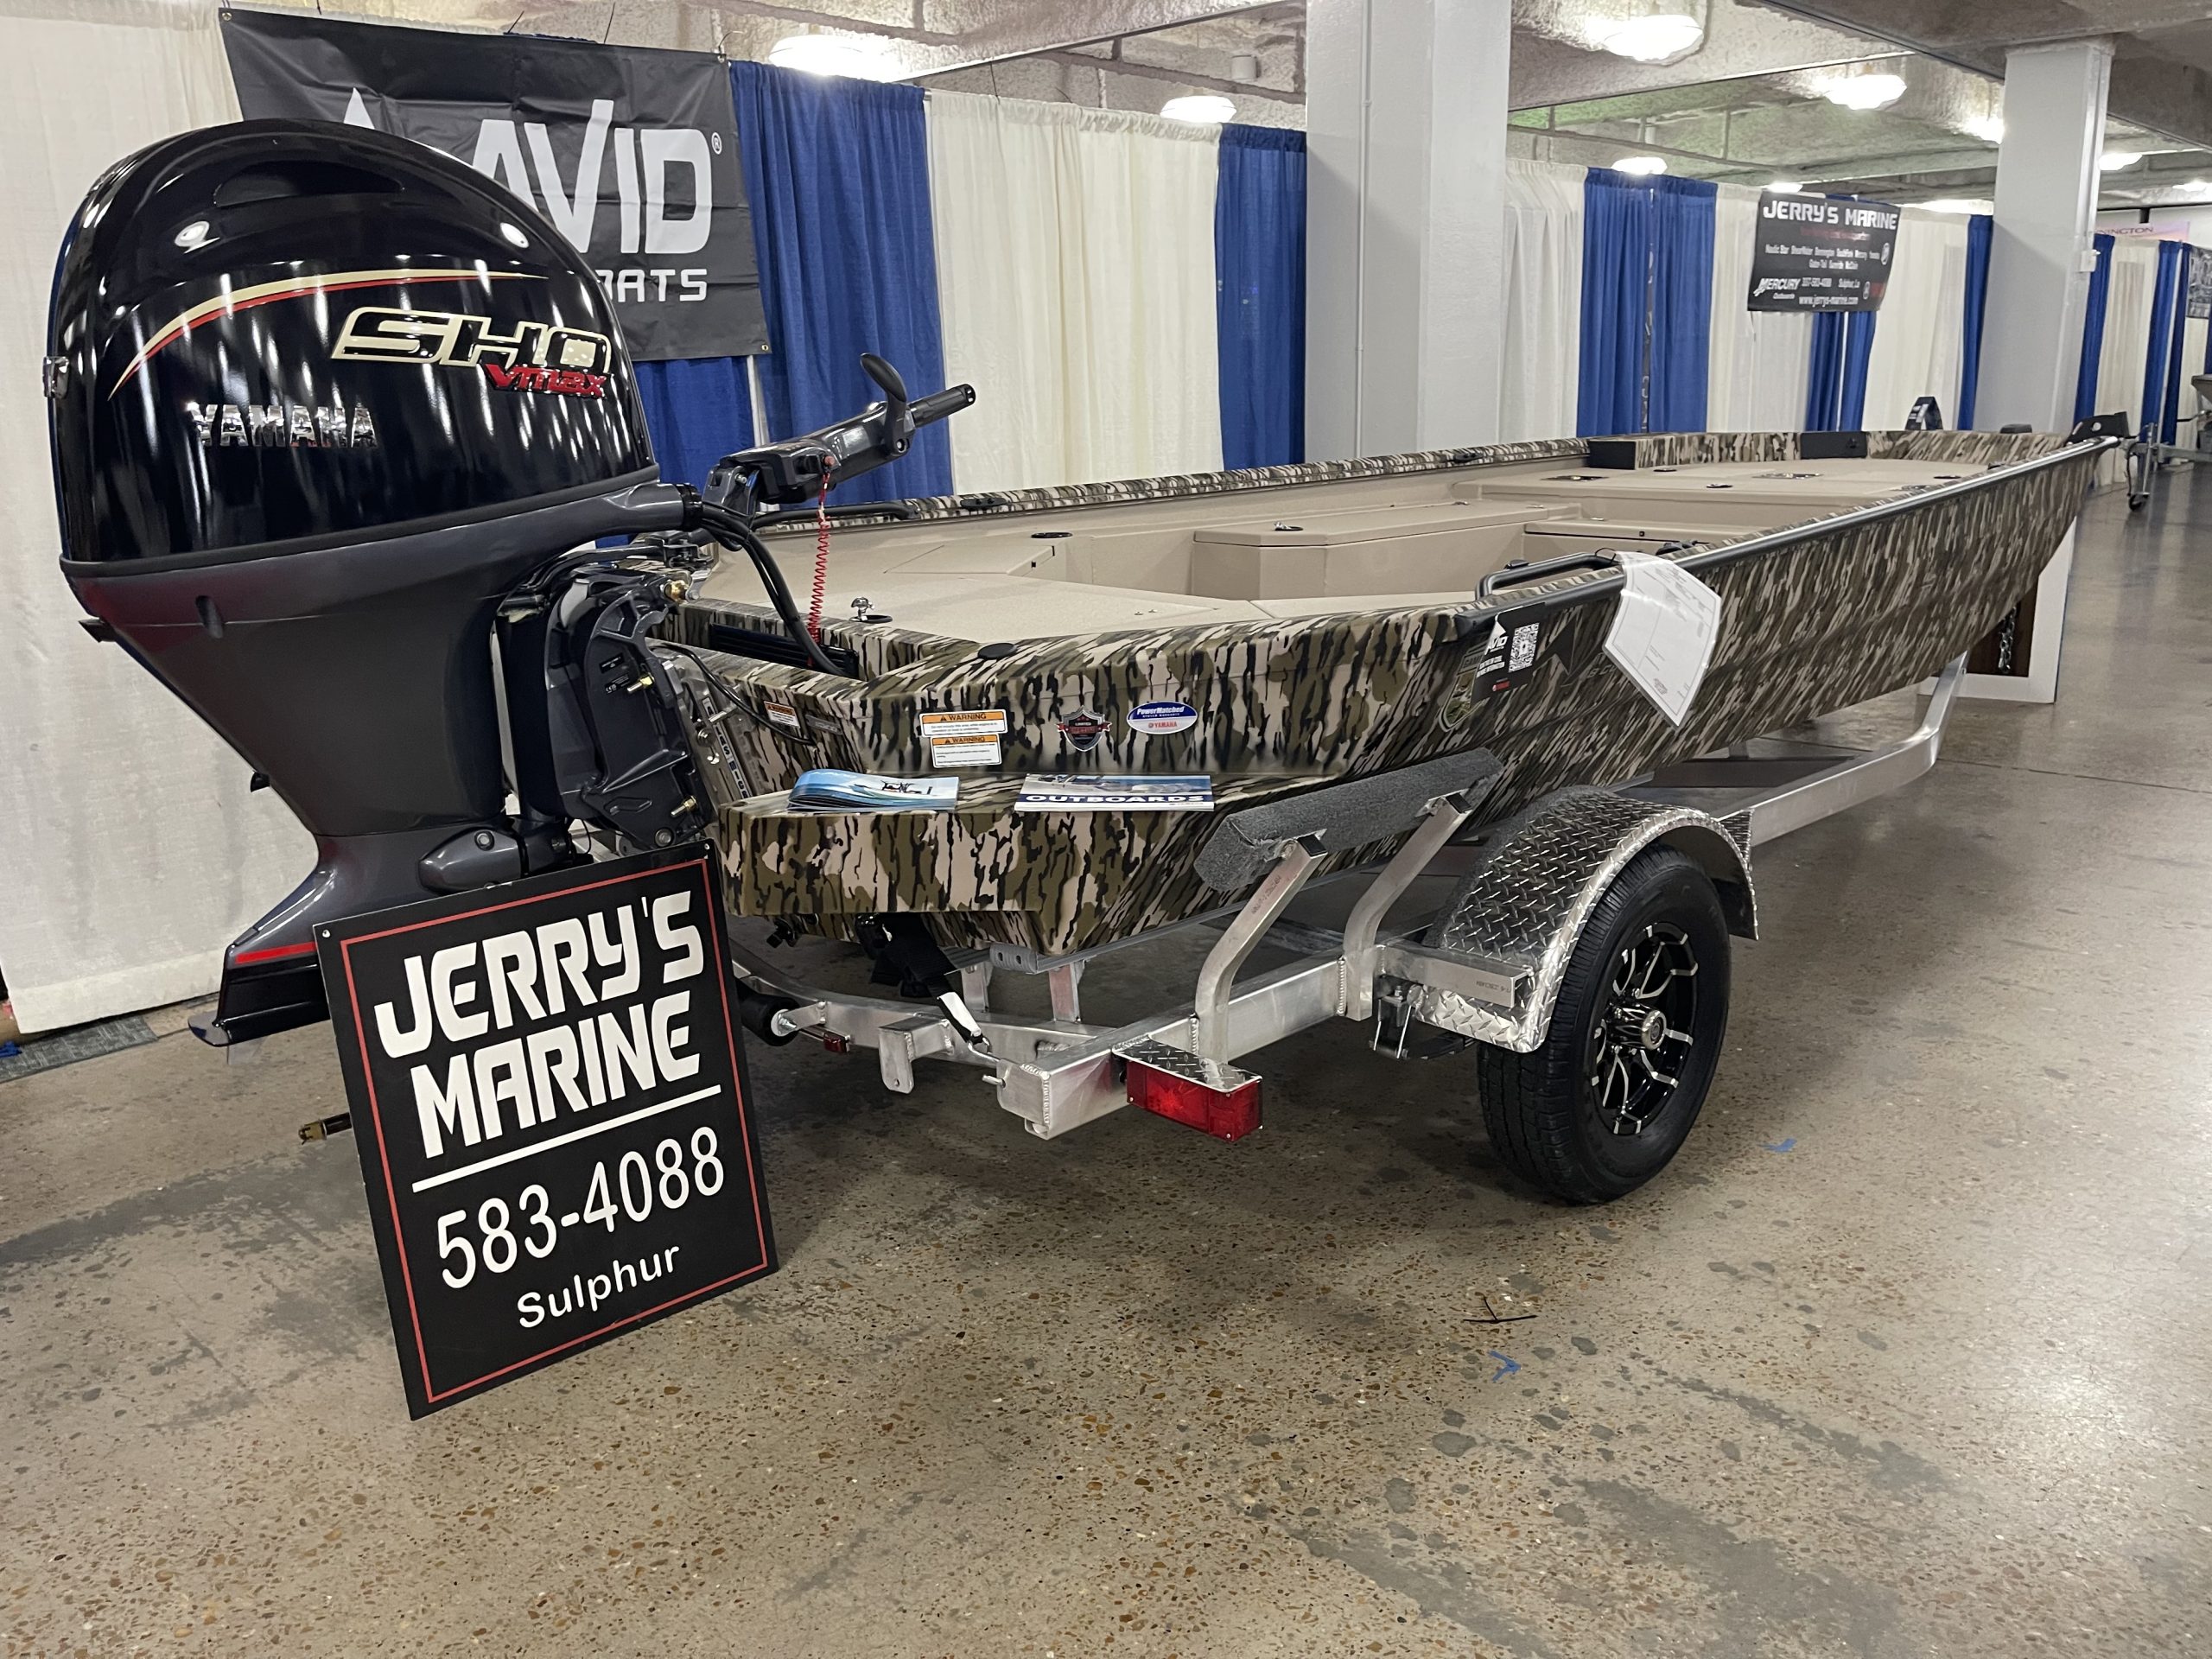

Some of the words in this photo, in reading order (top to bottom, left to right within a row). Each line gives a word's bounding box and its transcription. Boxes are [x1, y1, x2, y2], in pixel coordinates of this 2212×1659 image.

[1763, 200, 1839, 224] JERRY'S
[1846, 207, 1897, 231] MARINE
[595, 269, 708, 302] ATS
[1755, 277, 1801, 294] MERCURY
[331, 306, 612, 373] SHO
[187, 402, 378, 448] YAMAHA
[949, 712, 987, 721] WARNING
[1136, 705, 1185, 715] PowerMatched
[1026, 794, 1205, 803] OUTBOARDS
[374, 890, 704, 1058] JERRY'S
[410, 989, 702, 1159] MARINE
[437, 1126, 725, 1289] 583-4088
[517, 1244, 680, 1329] Sulphur
